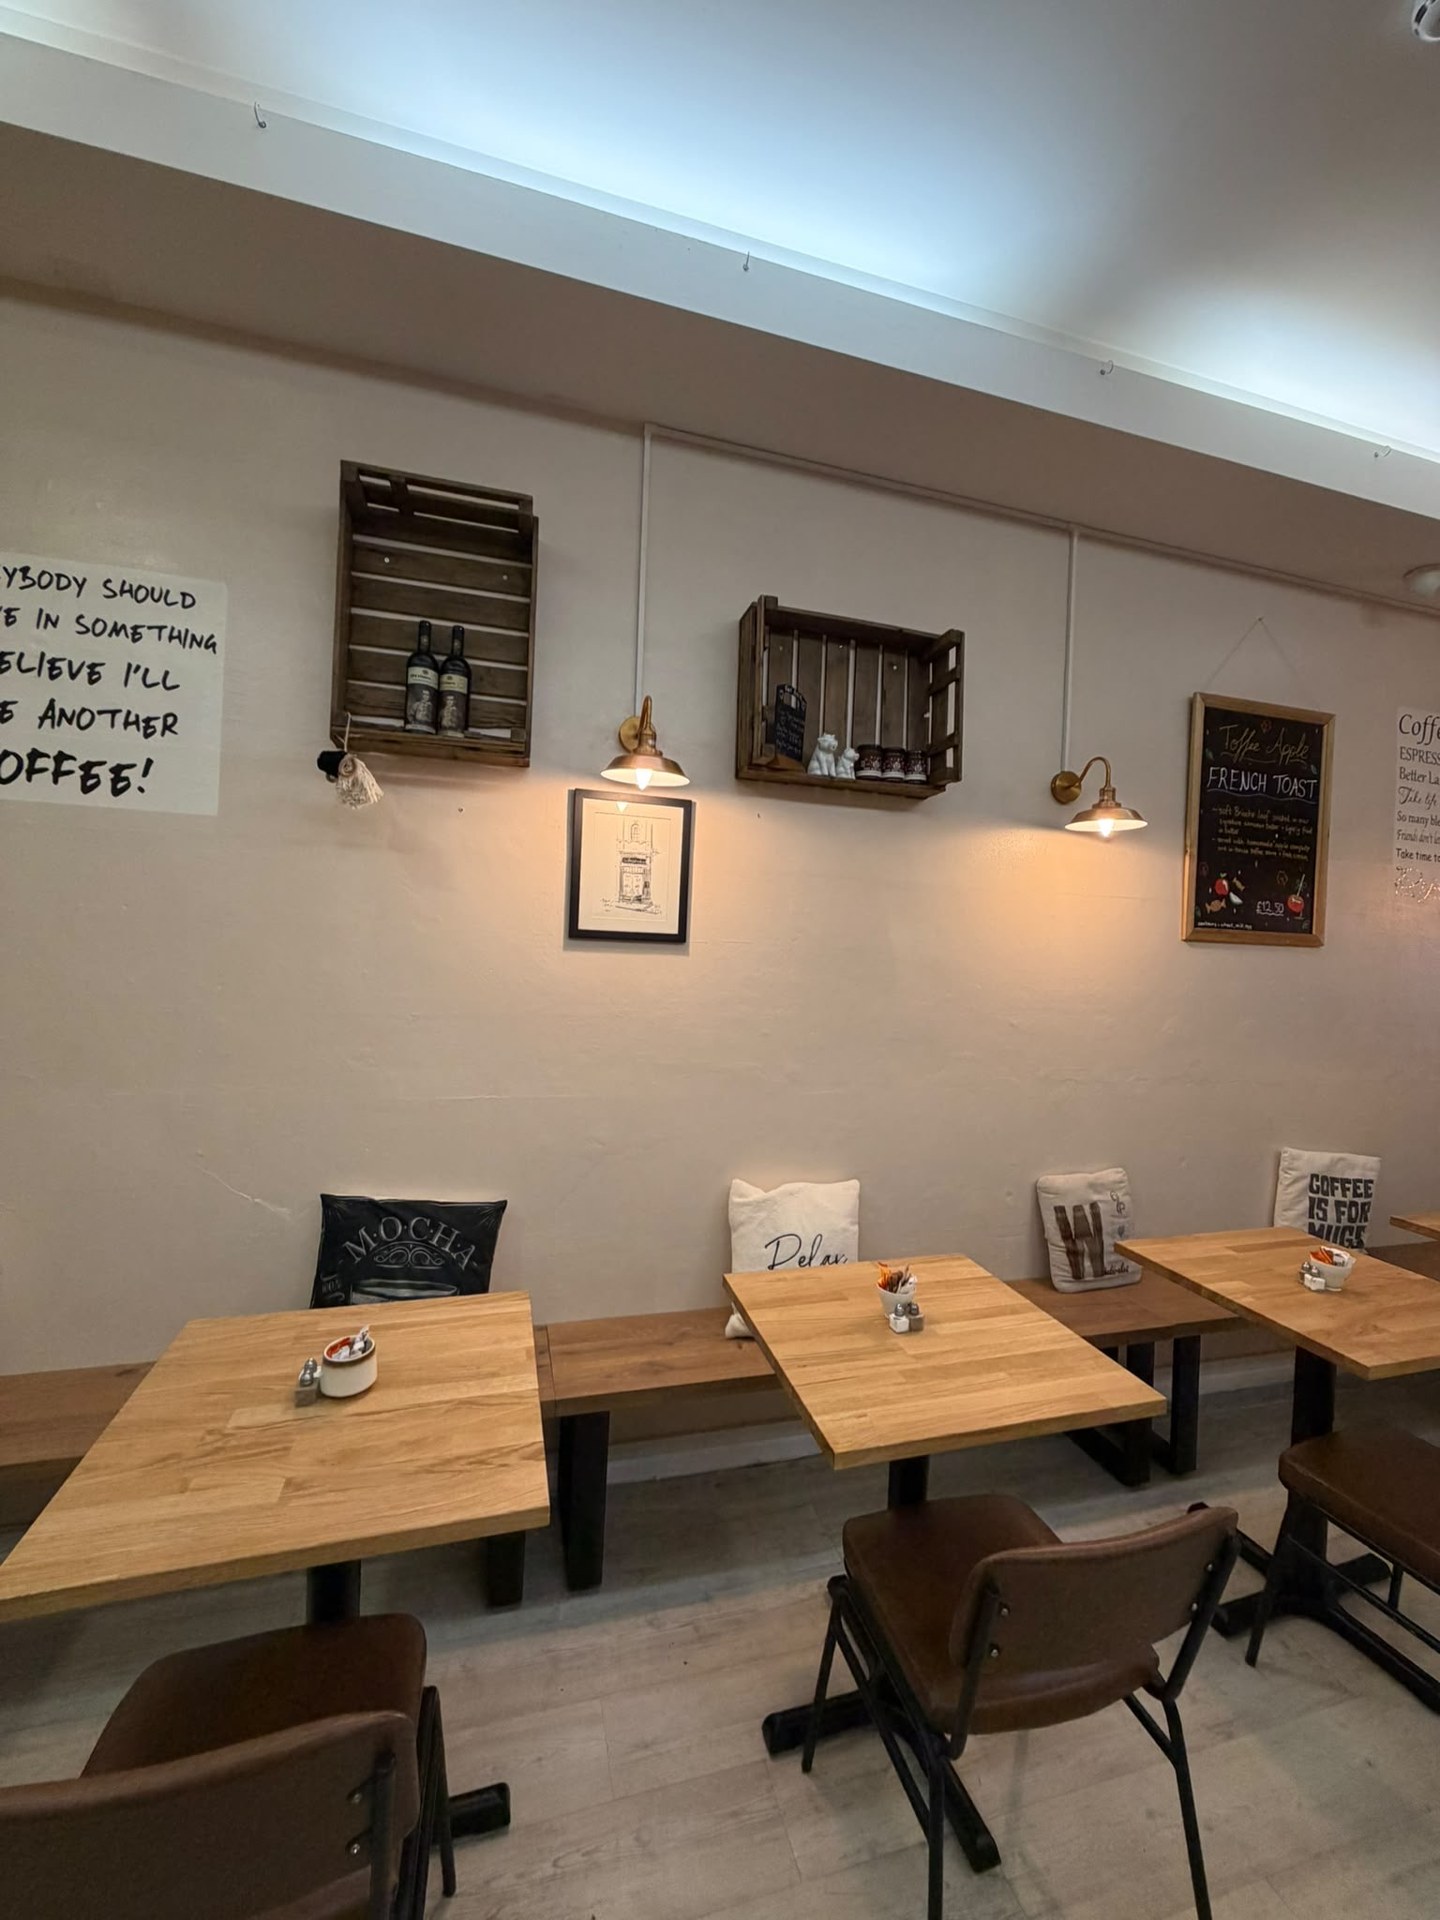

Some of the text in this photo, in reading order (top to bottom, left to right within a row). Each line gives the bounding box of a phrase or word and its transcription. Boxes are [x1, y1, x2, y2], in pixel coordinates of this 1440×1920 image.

[0, 566, 196, 610] YBODY SHOULD
[36, 608, 60, 630] IN
[75, 614, 217, 655] SOMETHING
[124, 662, 180, 691] I'LL
[38, 698, 179, 740] ANOTHER
[1265, 727, 1310, 765] Apple
[0, 747, 154, 798] OFFEE!
[1206, 766, 1318, 799] FRENCH TOAST
[1399, 766, 1427, 783] Better
[1396, 810, 1407, 822] So
[1408, 814, 1429, 828] many
[1396, 848, 1413, 860] Take
[1308, 1173, 1374, 1199] COFFEE
[1308, 1196, 1371, 1224] IS FOR
